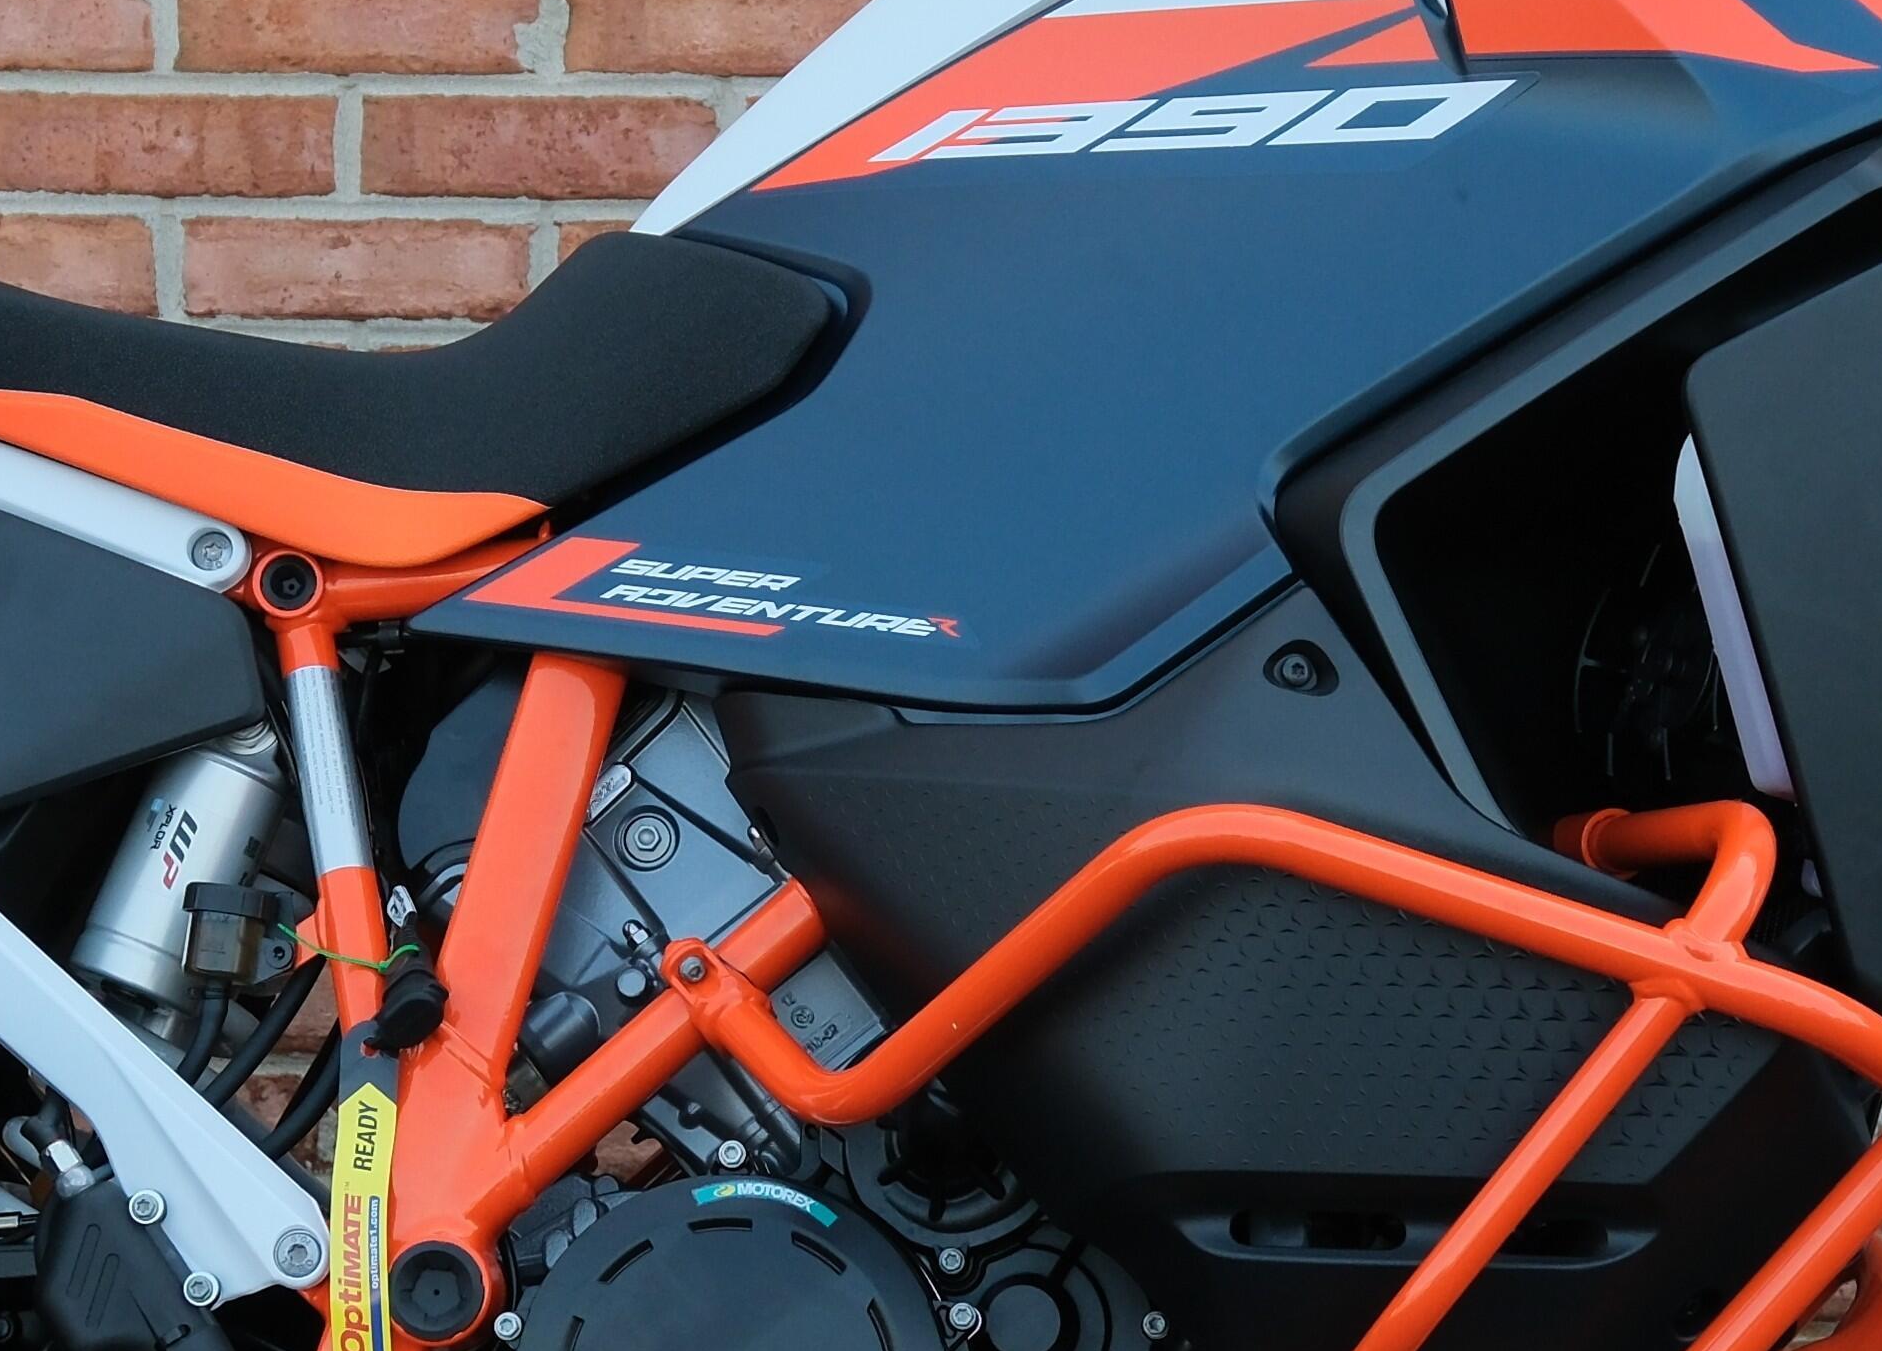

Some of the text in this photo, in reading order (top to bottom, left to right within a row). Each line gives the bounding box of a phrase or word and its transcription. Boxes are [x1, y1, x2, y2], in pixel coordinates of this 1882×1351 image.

[867, 79, 1517, 162] 1390
[609, 557, 803, 592] SUPER
[599, 583, 941, 638] ADVENTURE
[150, 804, 177, 850] XPLOR
[163, 809, 198, 889] WP
[353, 1100, 378, 1171] READY
[737, 1183, 815, 1212] MOTOREX
[370, 1198, 380, 1290] optimate1.com
